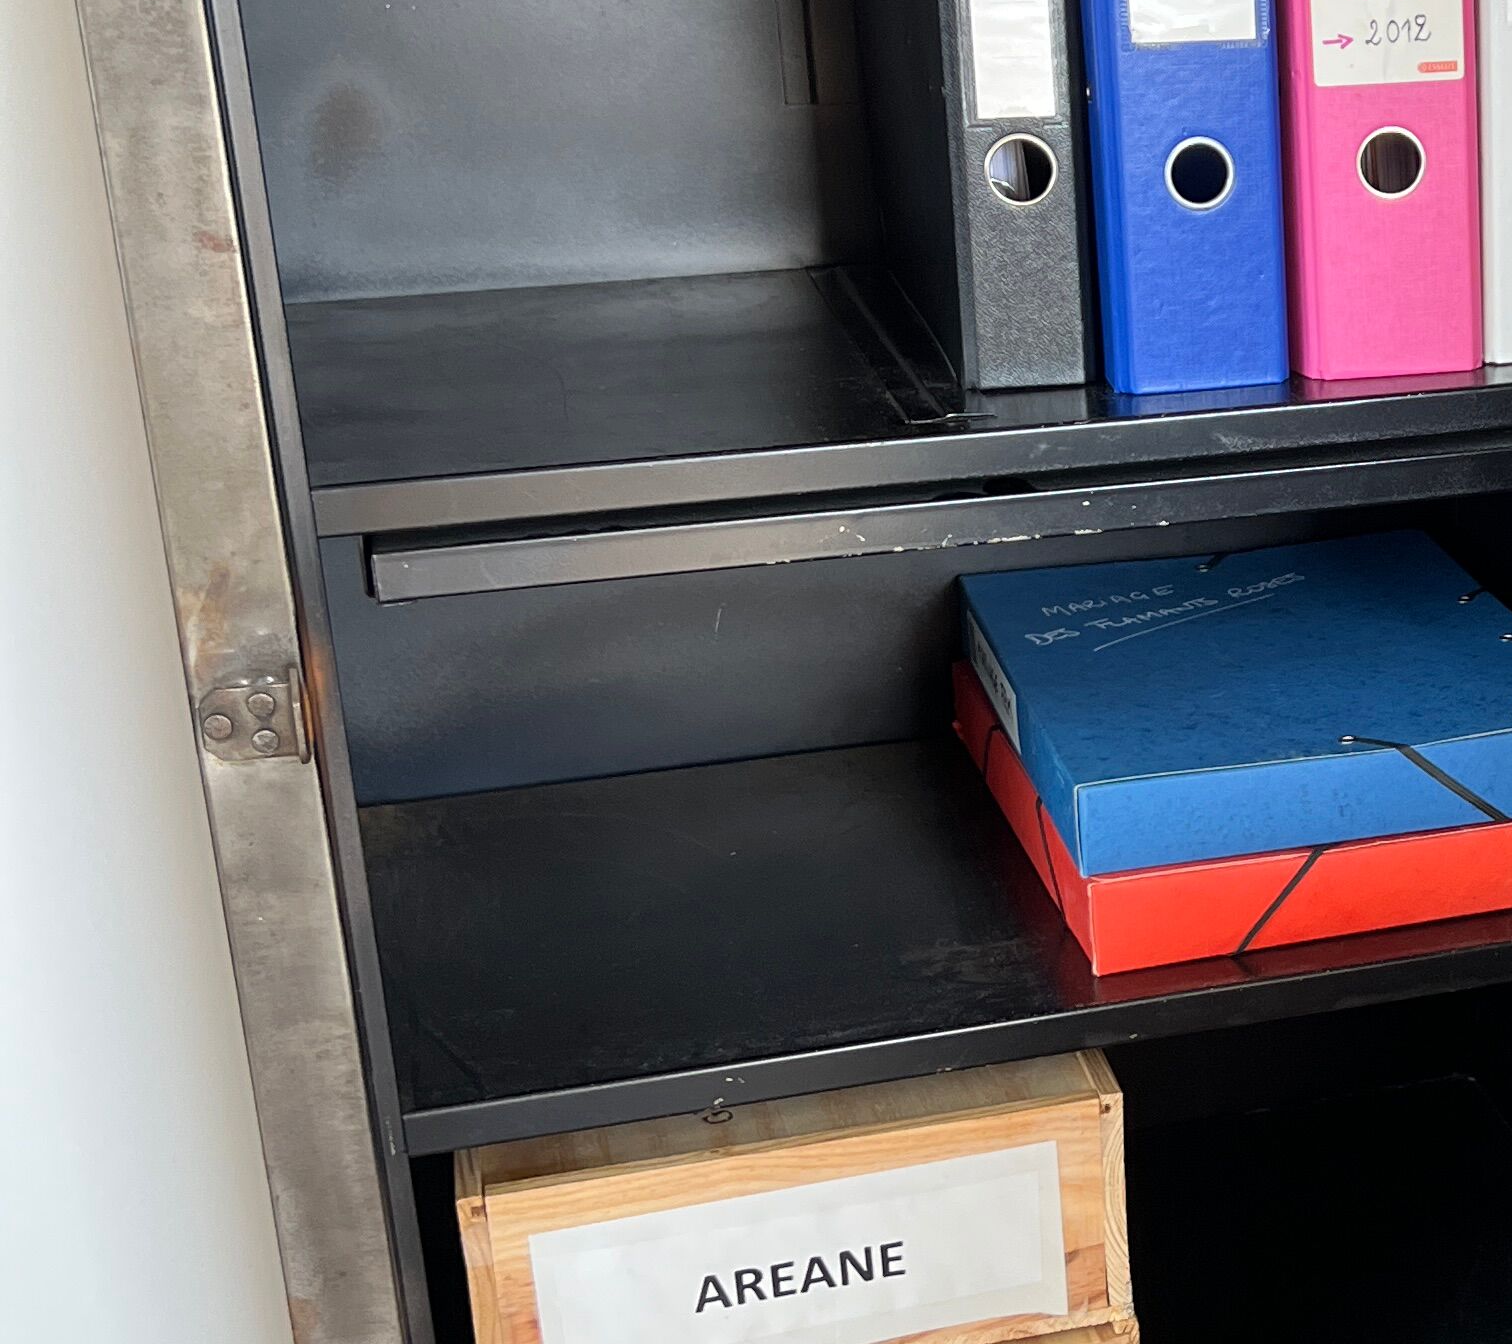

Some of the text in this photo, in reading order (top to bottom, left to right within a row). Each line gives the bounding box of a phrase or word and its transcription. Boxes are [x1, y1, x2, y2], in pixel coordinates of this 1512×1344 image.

[1364, 14, 1432, 47] 2012
[1041, 584, 1176, 617] MARIAGE
[694, 1240, 908, 1315] AREANE
